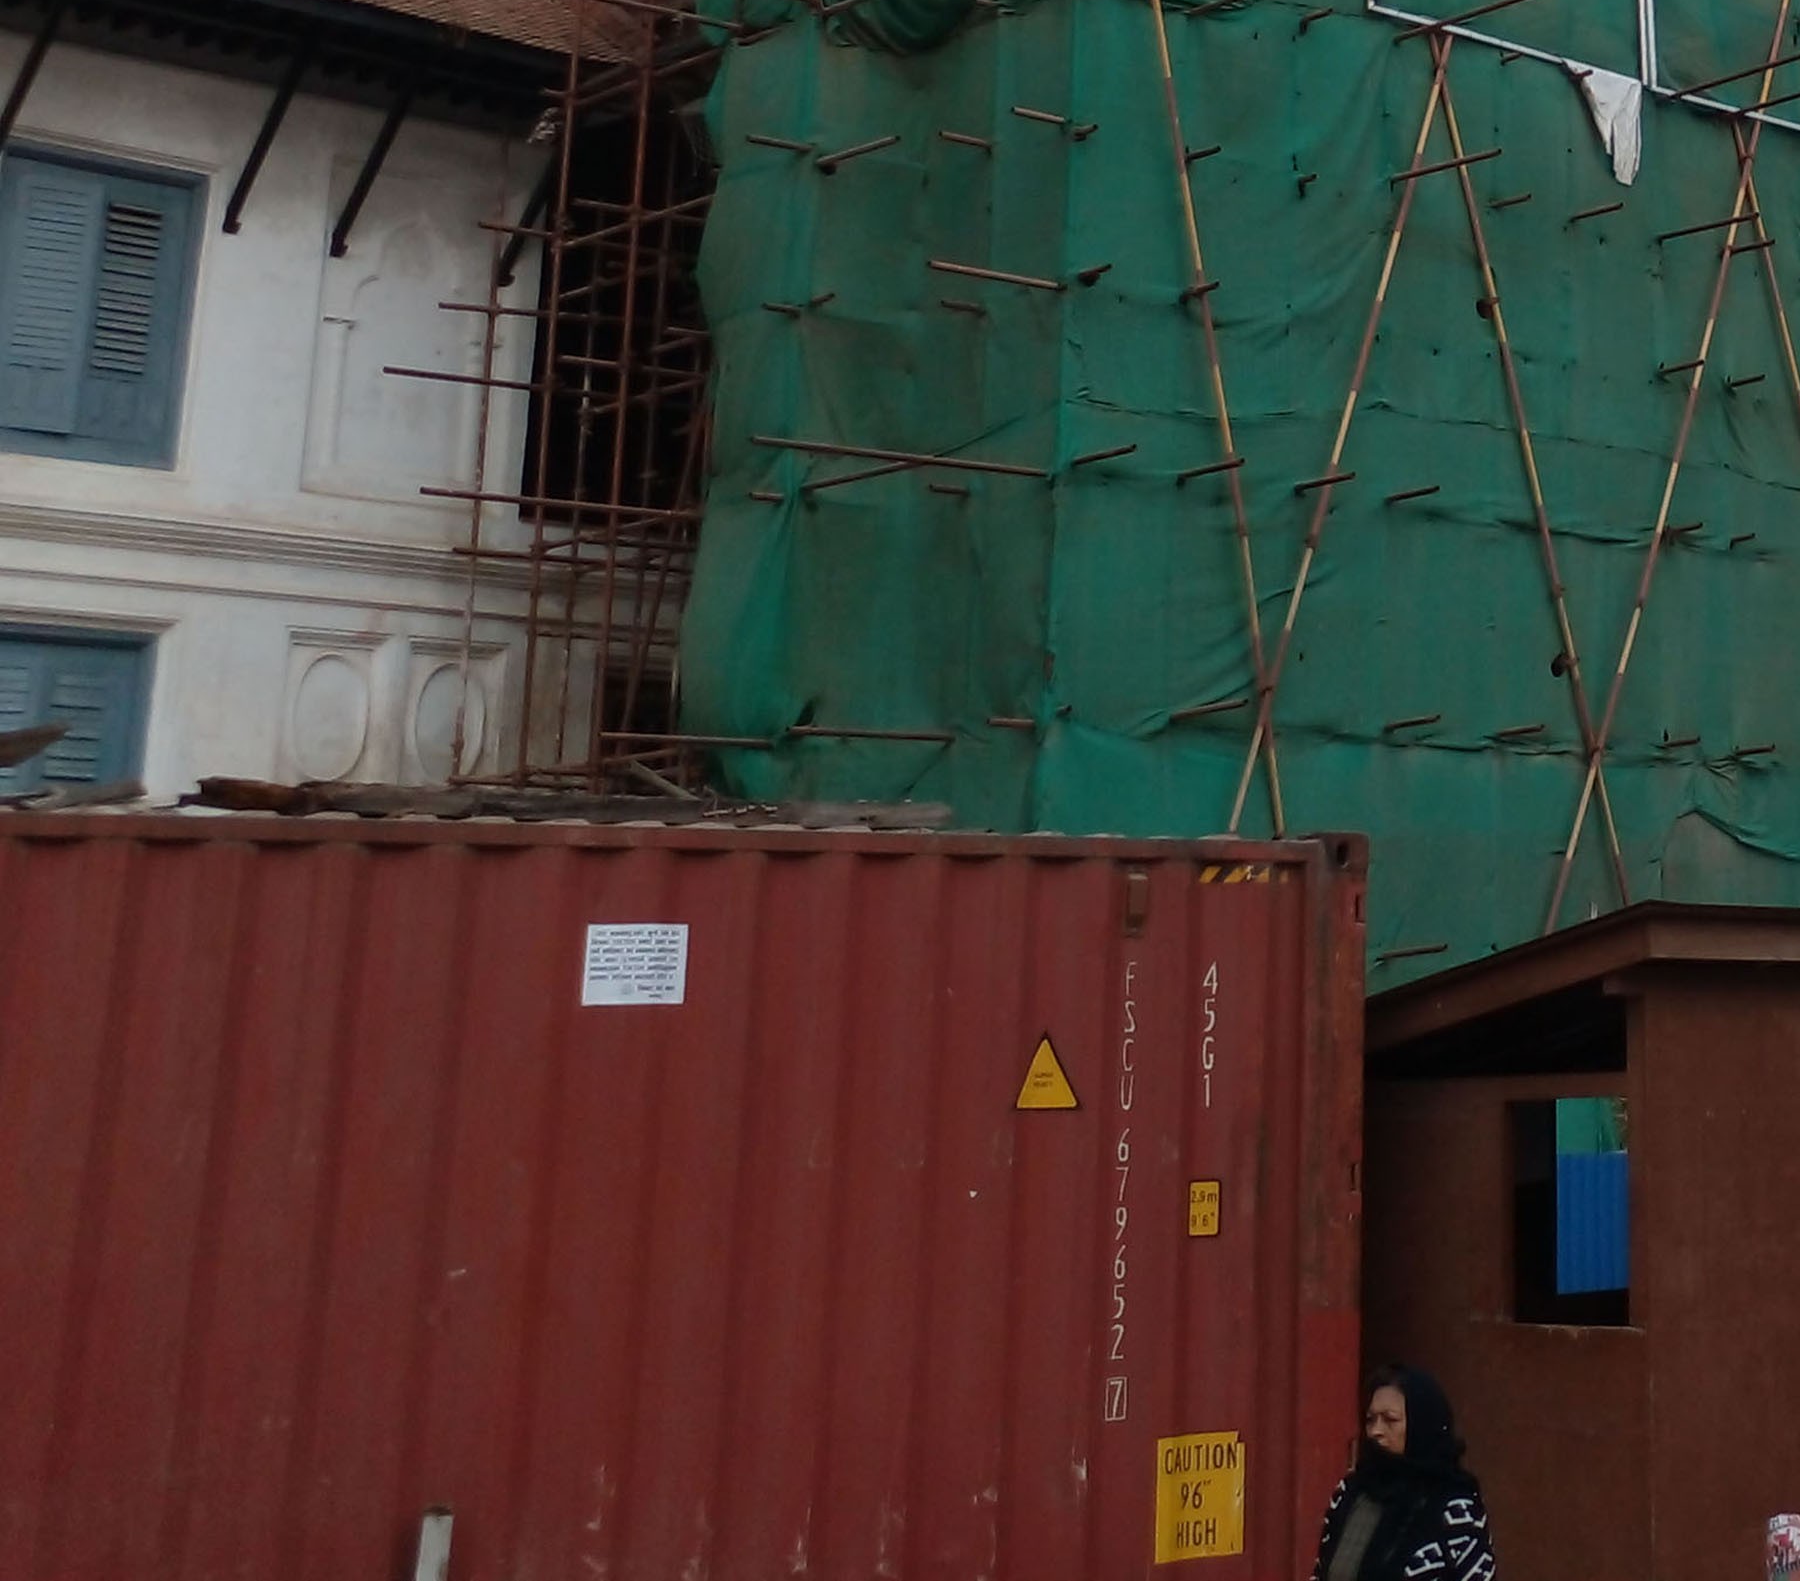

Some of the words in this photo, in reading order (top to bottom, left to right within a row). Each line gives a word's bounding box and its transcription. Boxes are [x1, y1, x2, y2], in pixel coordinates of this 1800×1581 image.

[1120, 961, 1137, 1110] FSCU
[1203, 961, 1218, 1108] 45G1
[1110, 1128, 1130, 1359] 679652
[1108, 1379, 1124, 1419] 7
[1165, 1442, 1237, 1474] CAUTION
[1177, 1518, 1216, 1548] HIGH
